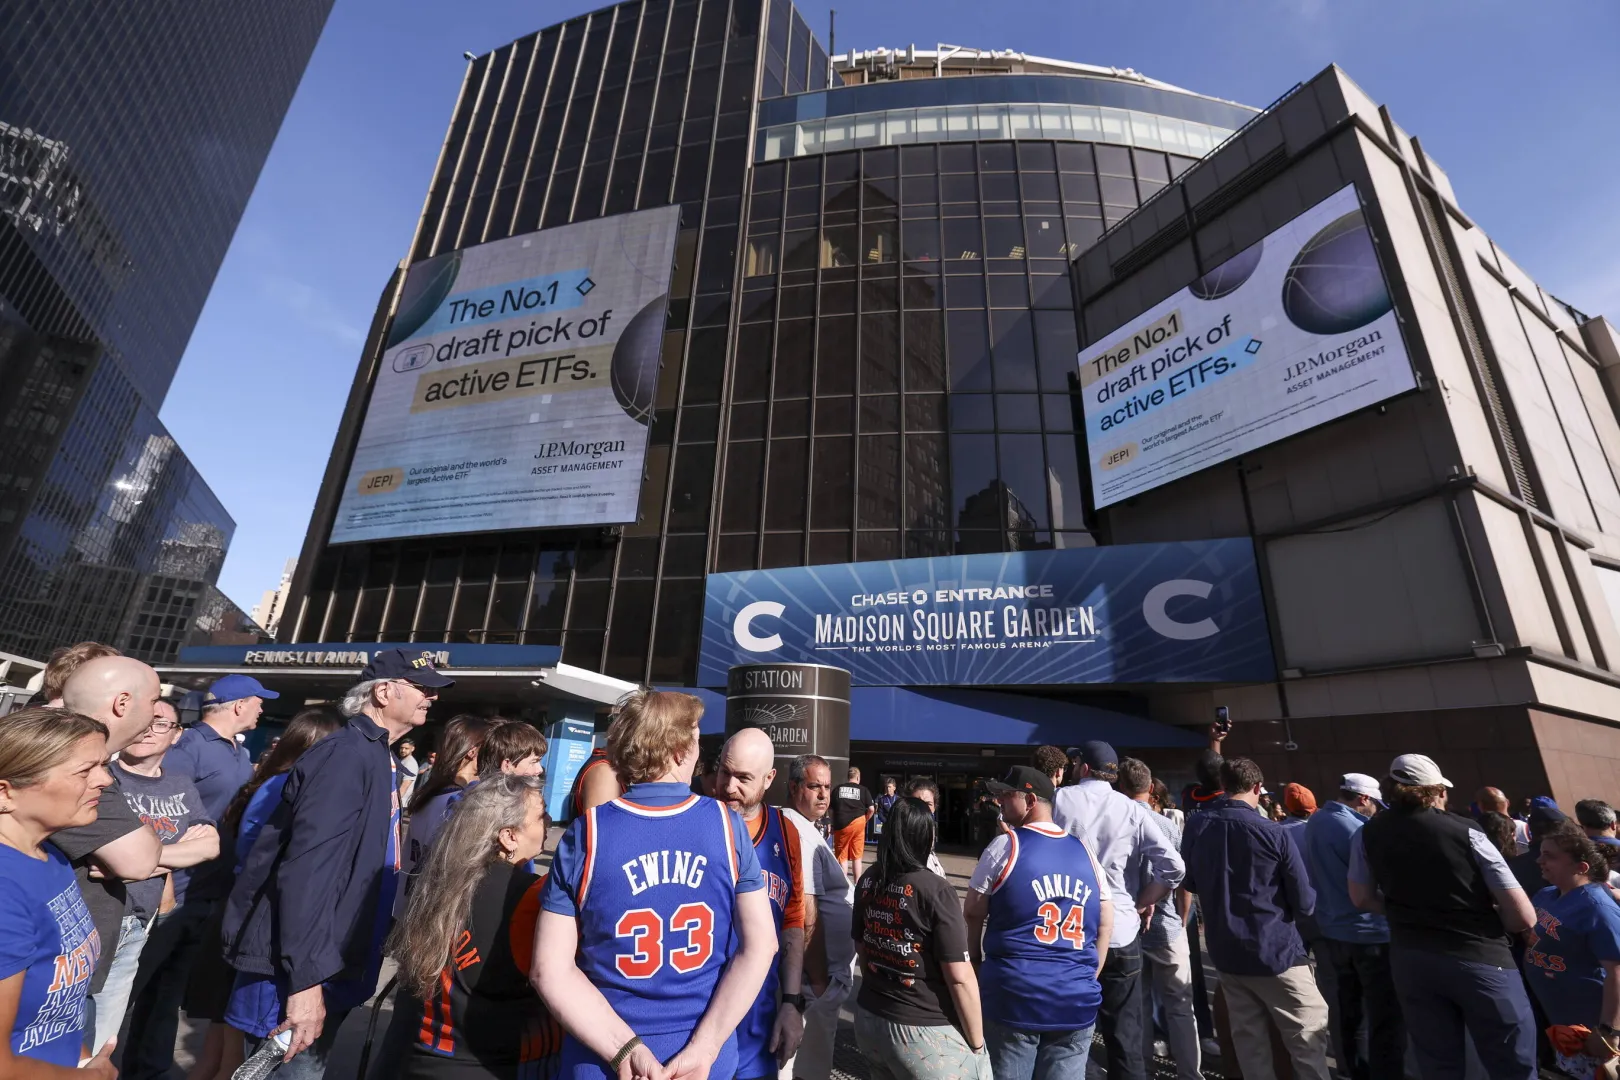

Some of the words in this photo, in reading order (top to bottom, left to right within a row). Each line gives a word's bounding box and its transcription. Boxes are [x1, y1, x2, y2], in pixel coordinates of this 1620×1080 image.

[449, 299, 495, 324] The
[500, 280, 559, 314] No.1
[436, 329, 503, 362] draft
[506, 317, 574, 357] pick
[577, 309, 613, 339] of
[1092, 348, 1130, 377] The
[1133, 313, 1179, 355] No.1
[1097, 364, 1147, 403] draft
[1151, 336, 1203, 380] pick
[1206, 314, 1232, 345] of
[1286, 377, 1314, 395] ASSET
[1316, 345, 1386, 381] MANAGEMENT
[425, 369, 509, 402] active
[515, 354, 597, 389] ETFs.
[1101, 389, 1164, 431] active
[1169, 356, 1237, 398] ETFs.
[1153, 425, 1177, 440] original
[1177, 418, 1191, 429] and
[1191, 414, 1203, 422] the
[1188, 420, 1209, 433] Active
[409, 467, 423, 475] Our
[423, 464, 450, 475] original
[450, 462, 465, 471] and
[465, 461, 479, 469] the
[531, 465, 558, 475] ASSET
[560, 460, 624, 473] MANAGEMENT
[1107, 448, 1130, 465] JEPI
[367, 474, 393, 489] JEPI
[431, 474, 454, 483] Active
[852, 592, 909, 607] CHASE
[935, 585, 1054, 603] ENTRANCE
[1143, 579, 1221, 641] C
[733, 600, 786, 652] C
[815, 613, 905, 643] MADISON
[913, 609, 995, 641] SQUARE
[244, 650, 369, 665] PENNSYLVANIA
[852, 645, 872, 653] THE
[875, 644, 922, 652] WORLD'S
[926, 643, 956, 651] MOST
[961, 642, 1006, 650] FAMOUS
[745, 669, 803, 689] STATION
[622, 850, 708, 896] EWING
[1031, 873, 1092, 906] OAKLEY
[615, 901, 714, 979] 33
[1034, 902, 1085, 950] 34
